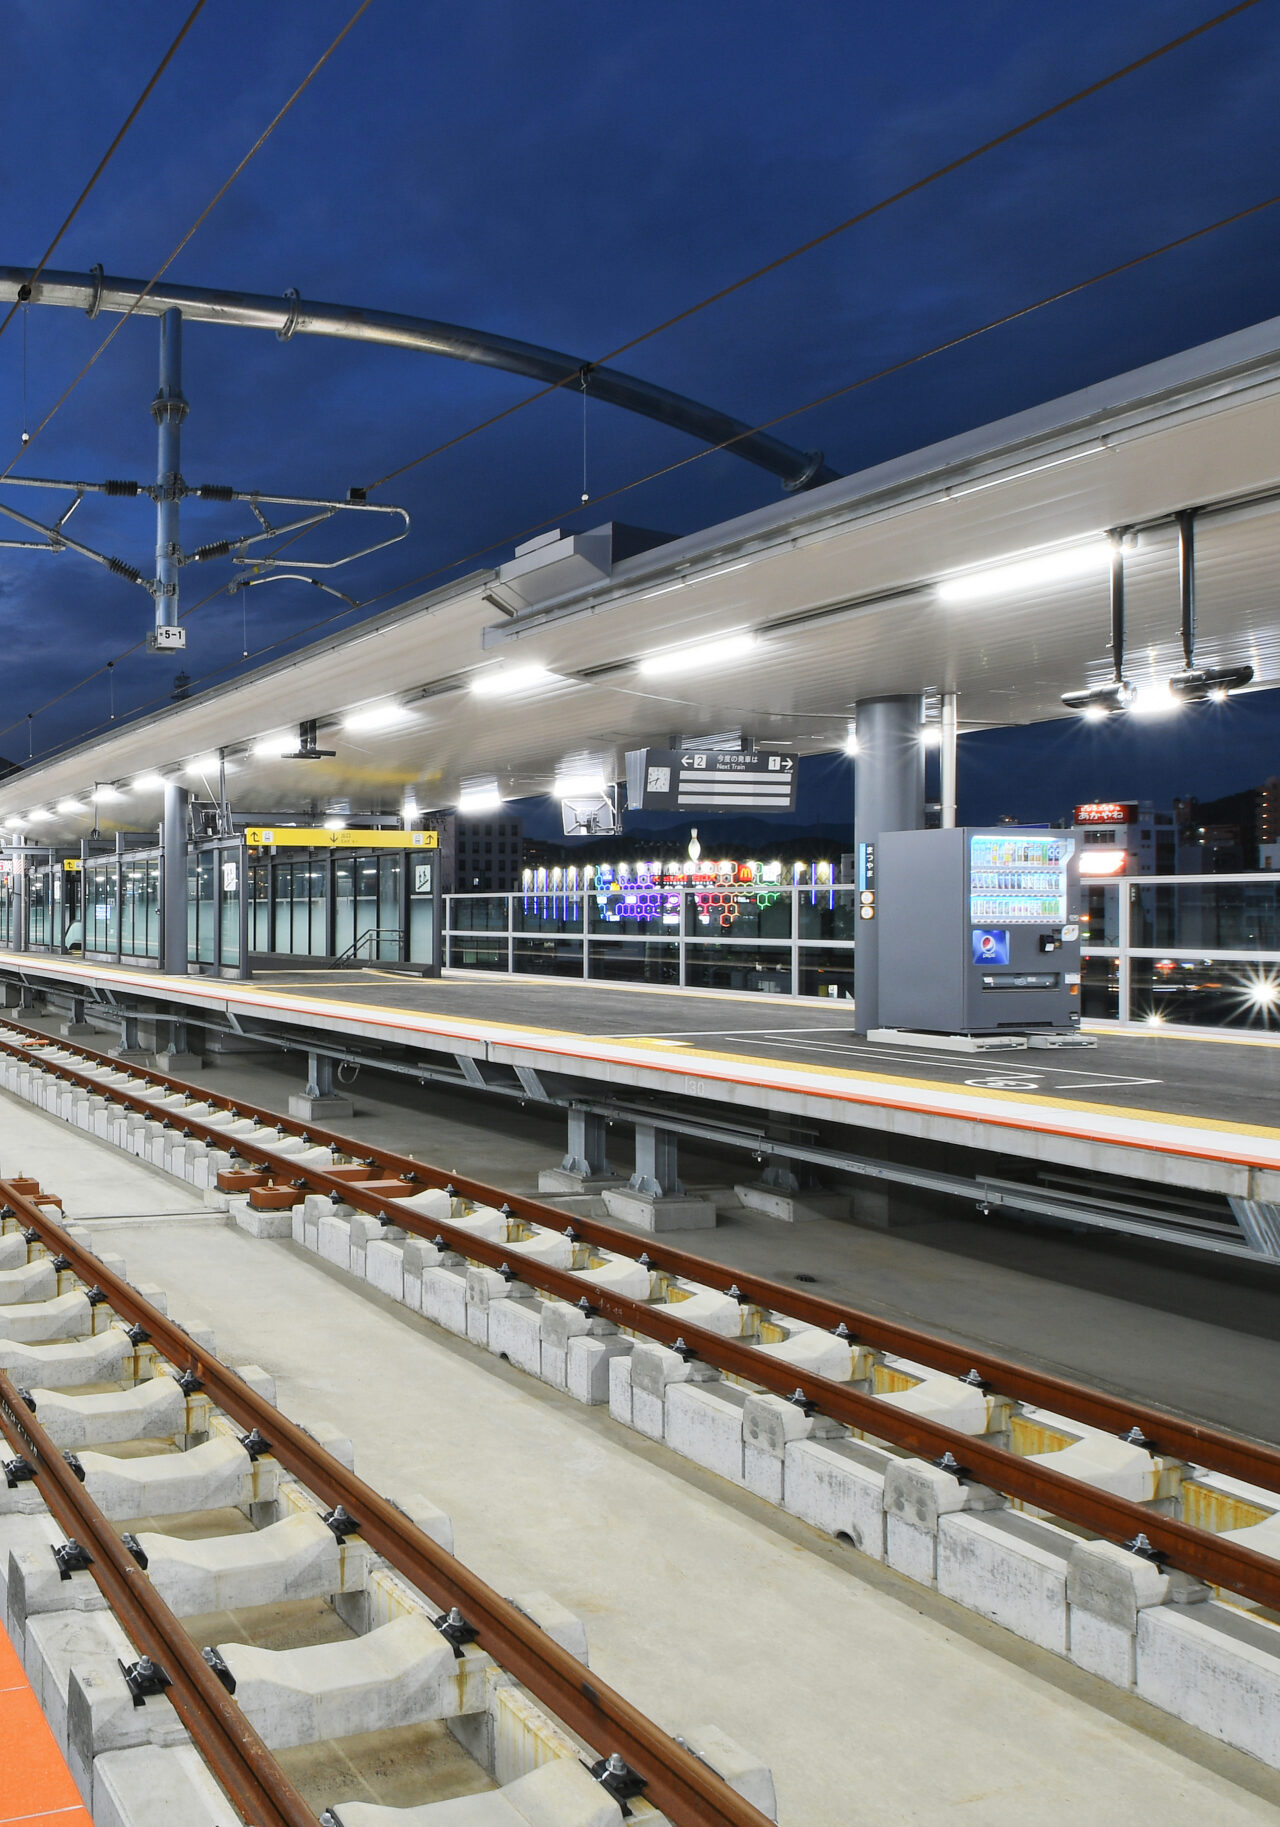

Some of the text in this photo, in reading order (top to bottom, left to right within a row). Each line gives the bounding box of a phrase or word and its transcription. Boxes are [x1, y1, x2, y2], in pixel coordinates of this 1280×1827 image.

[696, 756, 703, 767] 2
[772, 758, 777, 769] 1
[1078, 811, 1124, 820] あかやね
